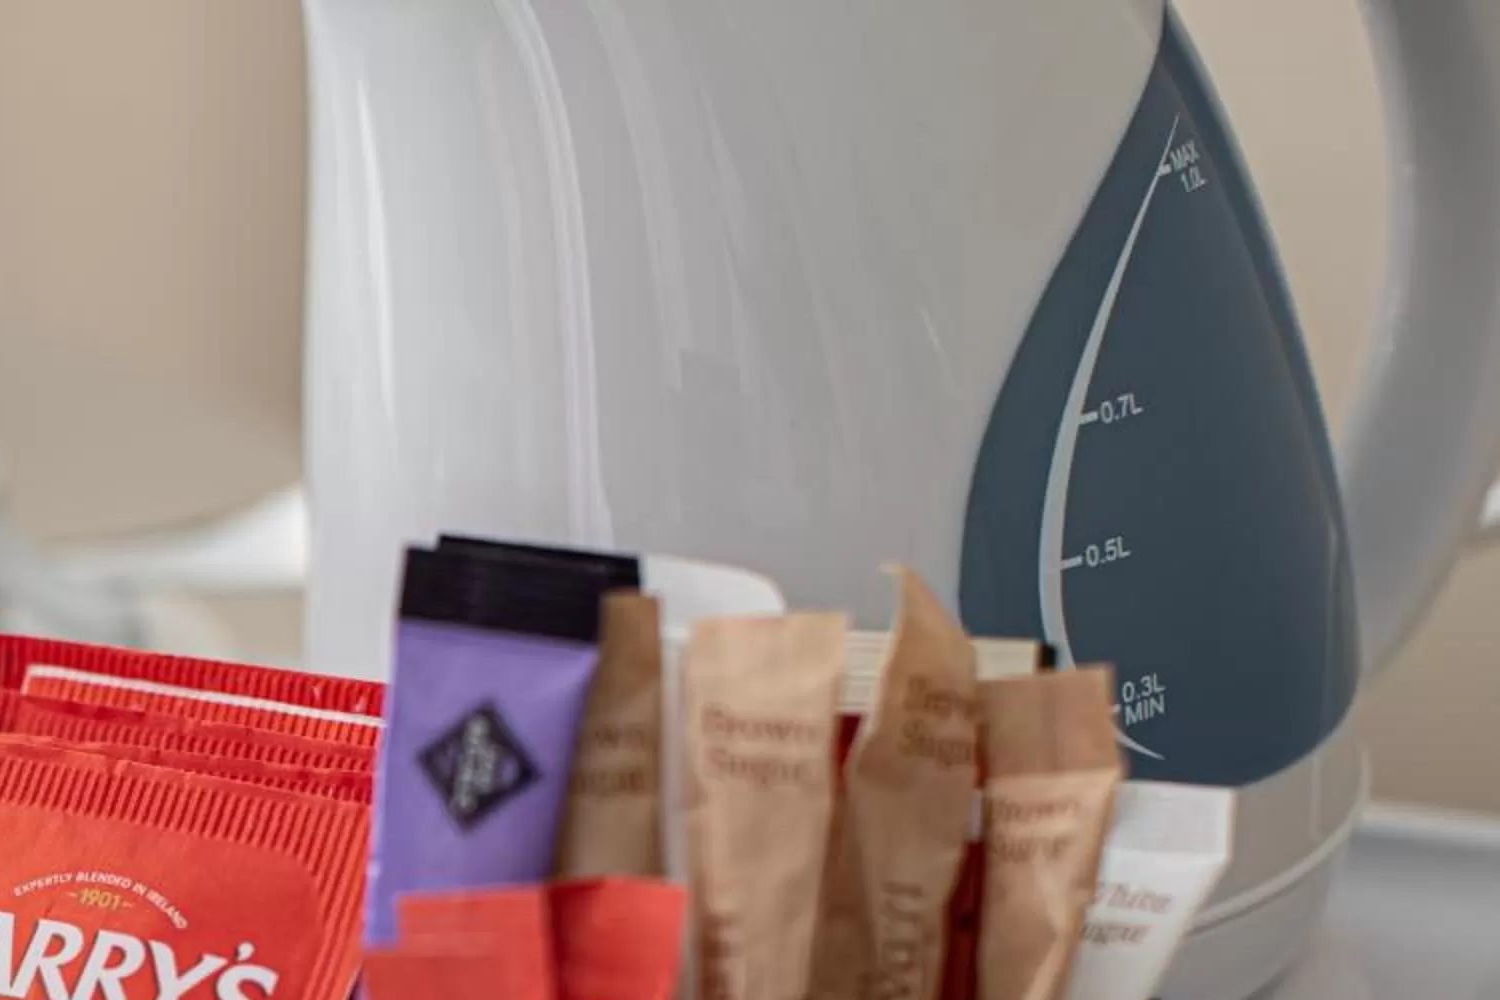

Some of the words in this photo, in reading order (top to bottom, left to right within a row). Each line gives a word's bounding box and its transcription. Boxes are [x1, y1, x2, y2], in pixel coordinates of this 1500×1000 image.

[1169, 140, 1200, 172] MAX
[1100, 393, 1143, 424] 0.7L
[1086, 536, 1131, 567] 0.5L
[1122, 672, 1165, 703] 0.3L
[1124, 696, 1165, 725] MIN
[13, 872, 73, 897] EXPERTLY
[75, 871, 131, 889] BLENDED
[132, 881, 147, 896] IN
[145, 889, 188, 929] IRELAND
